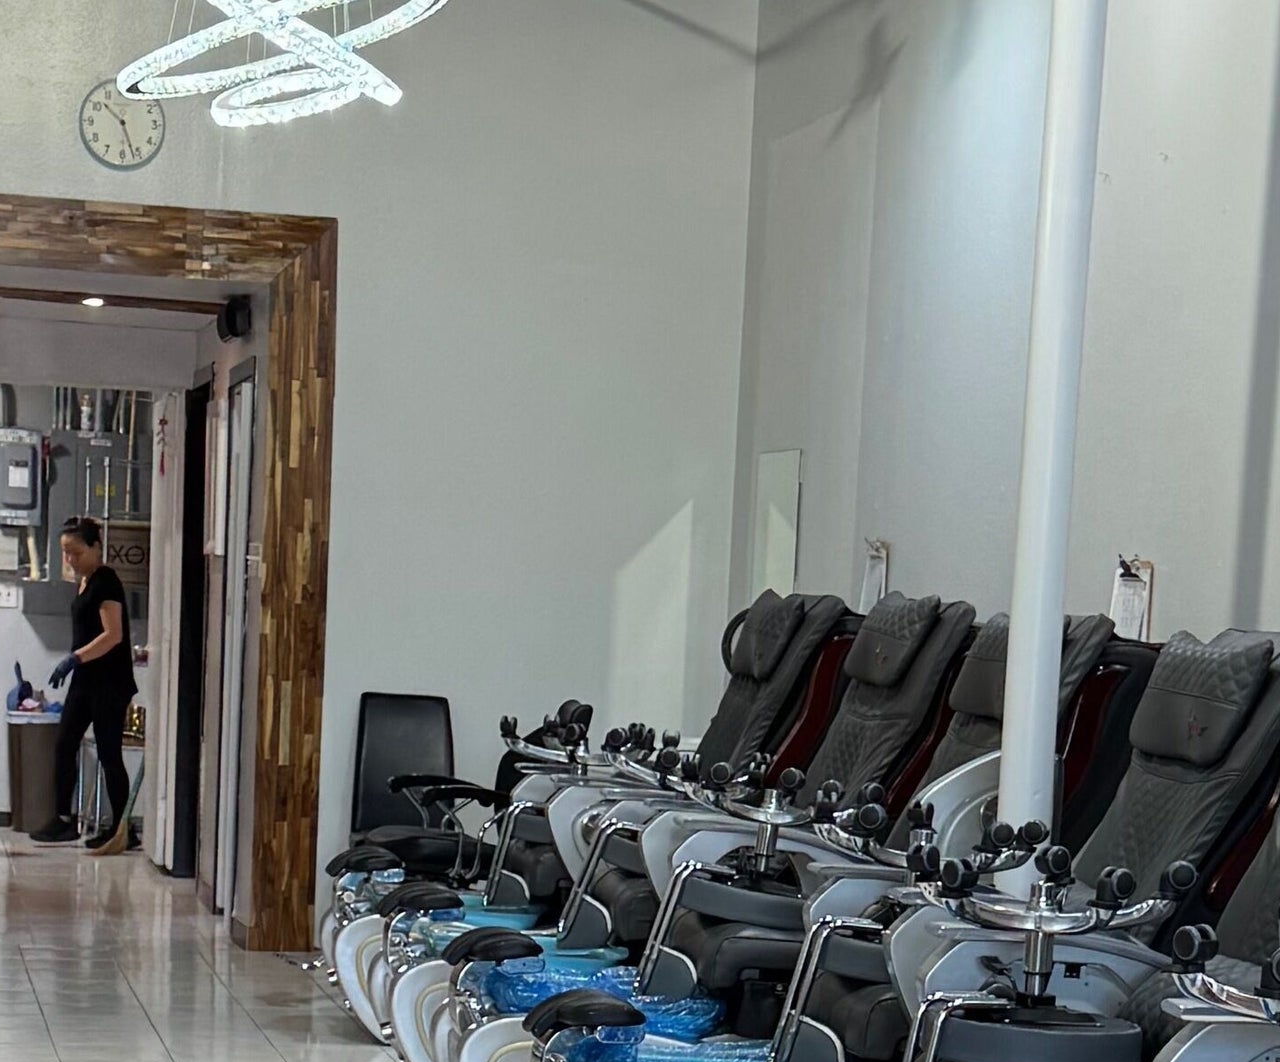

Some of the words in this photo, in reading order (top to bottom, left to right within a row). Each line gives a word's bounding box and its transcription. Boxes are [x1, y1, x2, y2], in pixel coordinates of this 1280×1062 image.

[104, 90, 112, 100] 11
[92, 101, 102, 111] 10
[146, 104, 153, 114] 2
[87, 116, 94, 126] 9
[151, 120, 158, 130] 3
[92, 133, 99, 143] 8
[146, 136, 153, 146] 4
[104, 144, 110, 154] 7
[119, 149, 126, 160] 6
